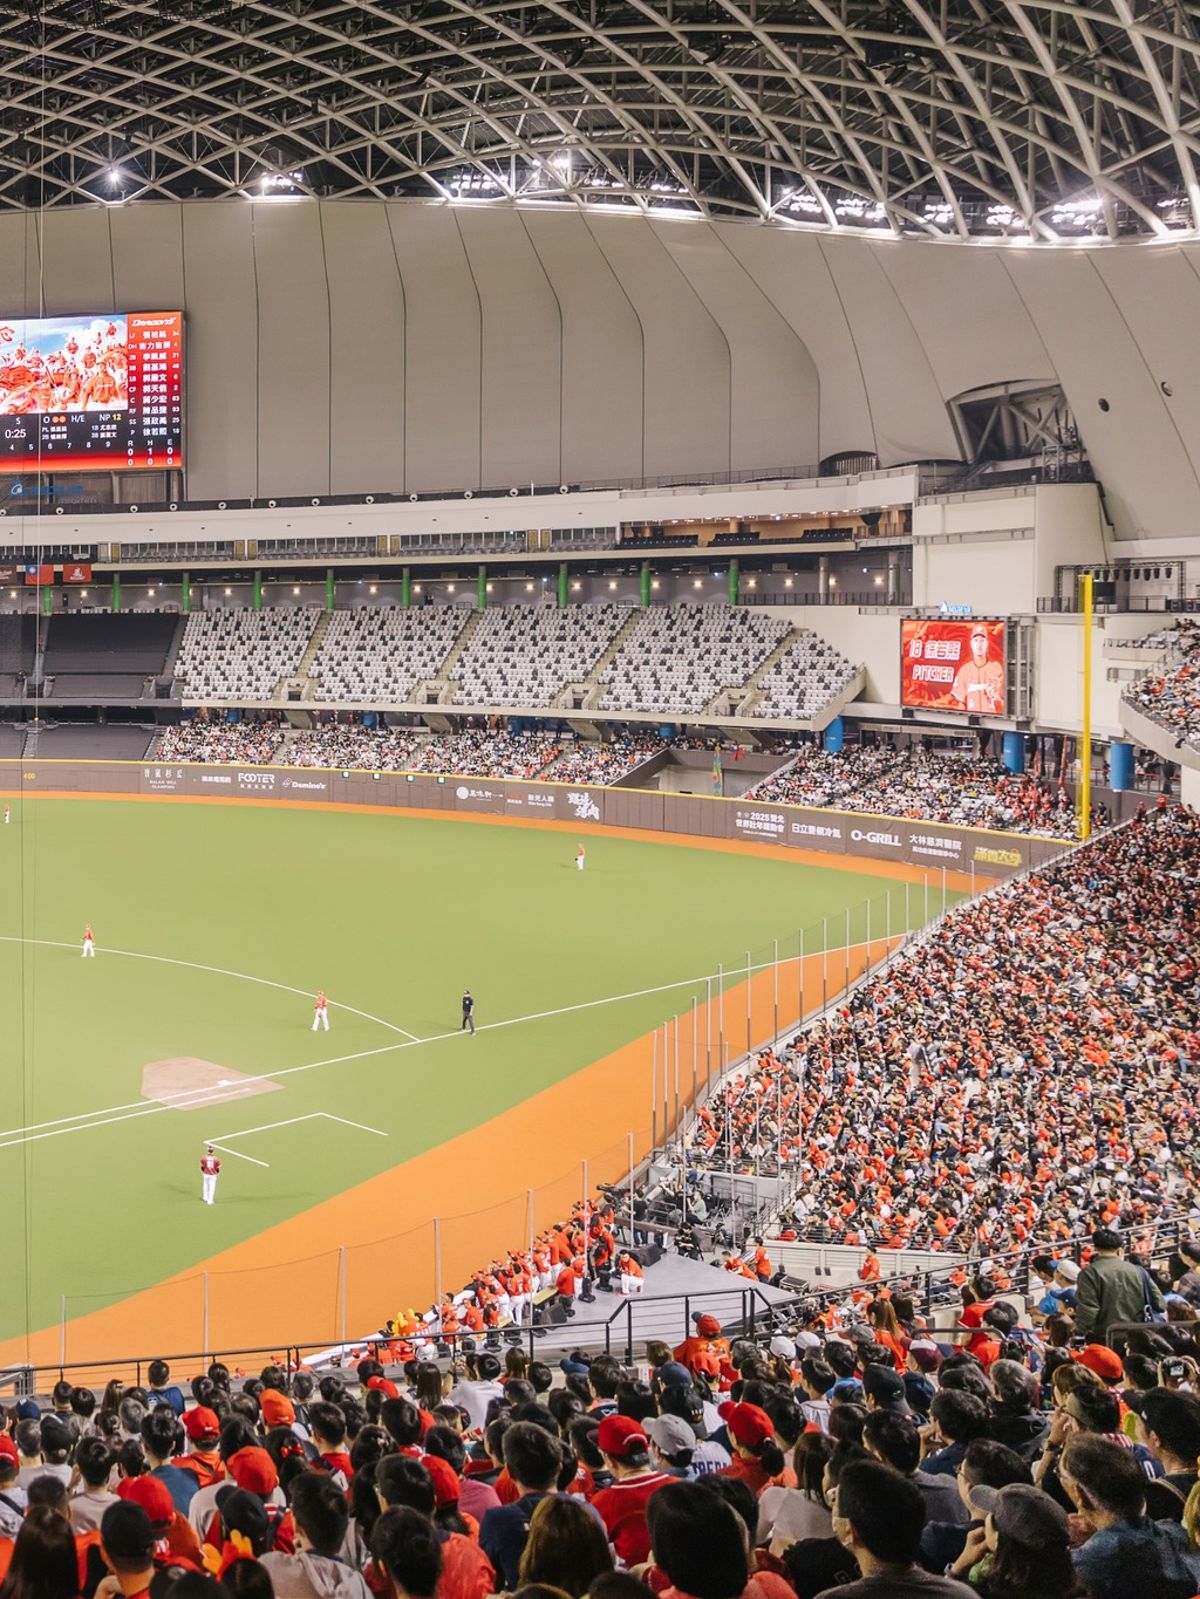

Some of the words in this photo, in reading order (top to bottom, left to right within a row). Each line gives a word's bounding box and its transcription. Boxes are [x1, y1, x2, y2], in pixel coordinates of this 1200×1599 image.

[5, 429, 26, 438] 0:25
[128, 448, 134, 456] 0
[167, 446, 173, 454] 0
[148, 458, 154, 466] 0
[909, 640, 922, 658] 18
[924, 640, 961, 660] 徐若熙
[912, 664, 954, 683] PITCHER
[238, 772, 276, 784] FOOTER
[292, 781, 327, 790] Domino's
[851, 830, 902, 846] O-GRILL
